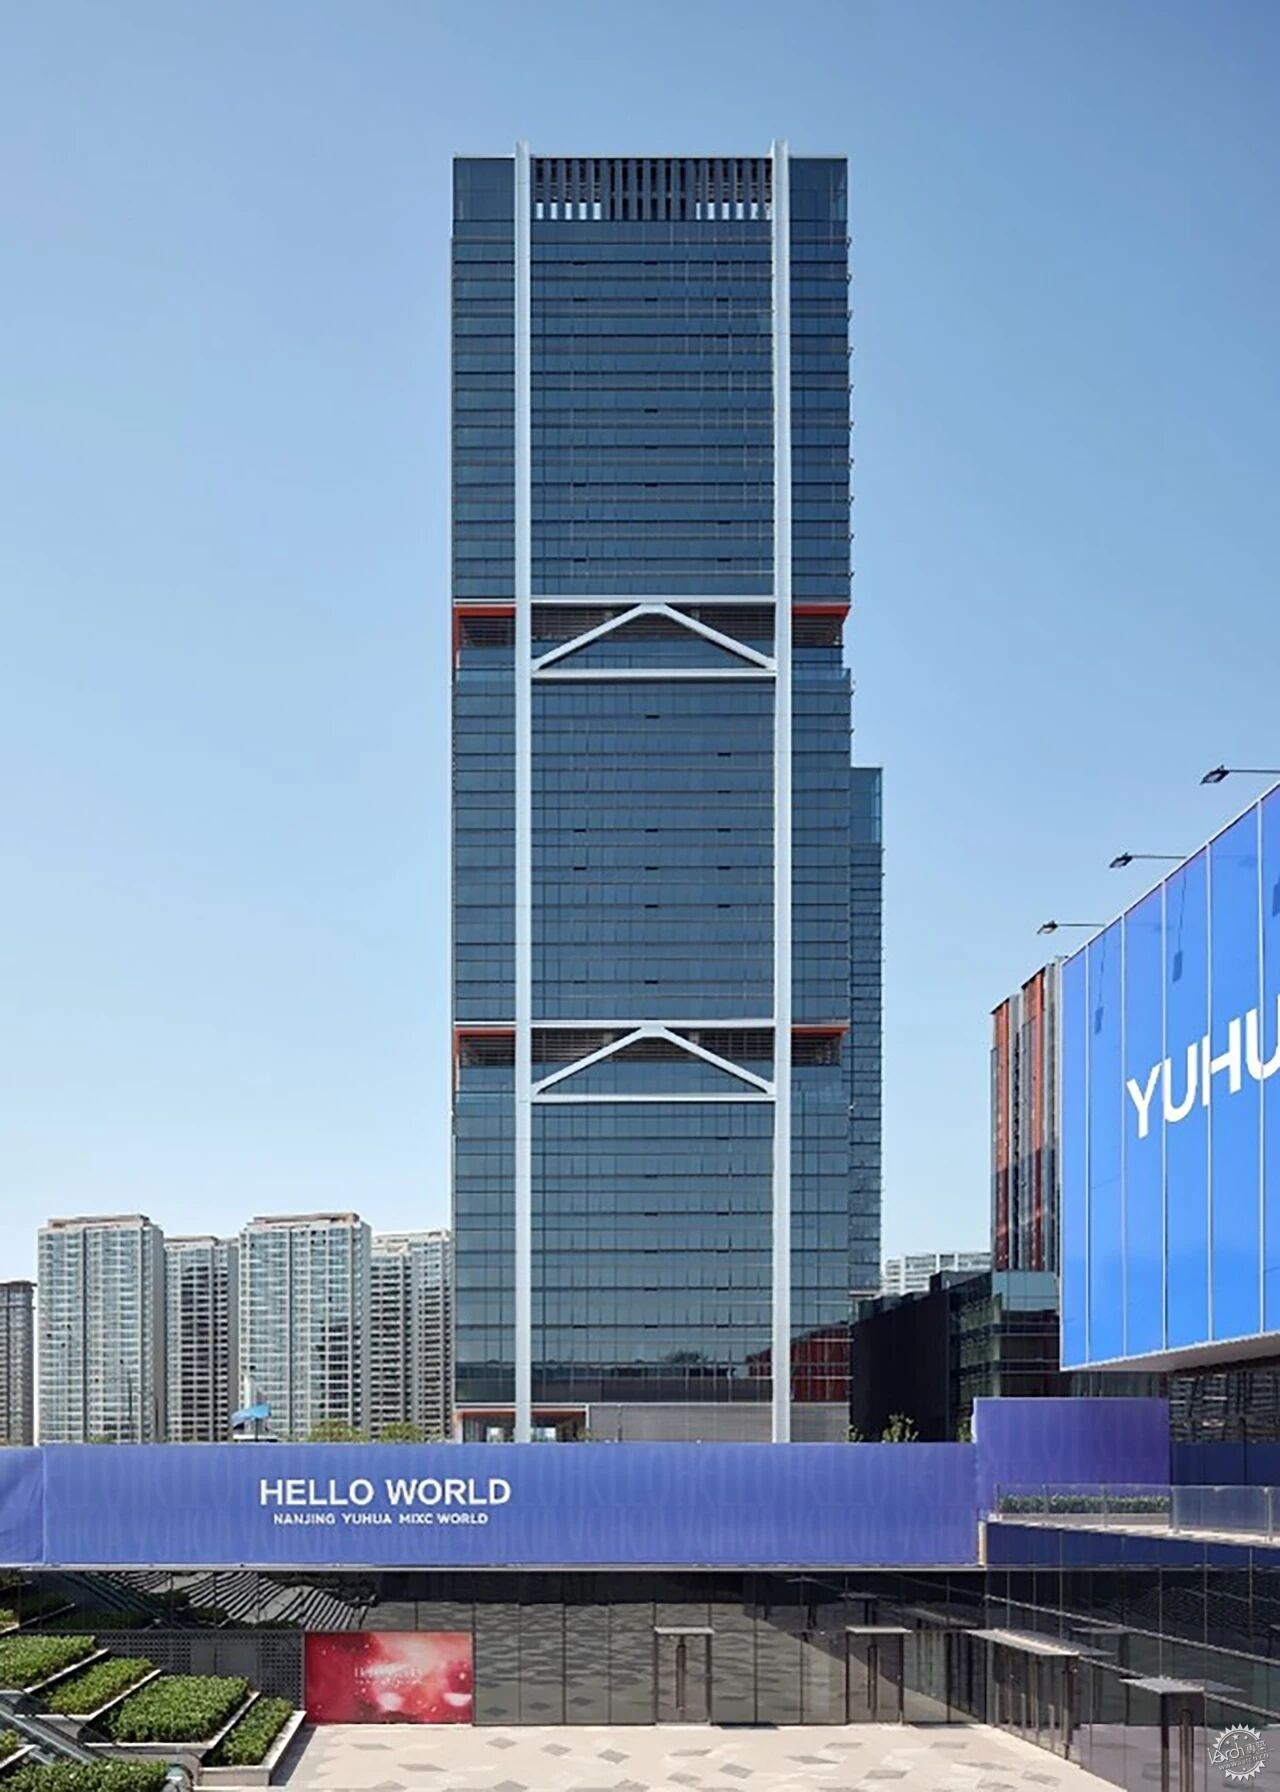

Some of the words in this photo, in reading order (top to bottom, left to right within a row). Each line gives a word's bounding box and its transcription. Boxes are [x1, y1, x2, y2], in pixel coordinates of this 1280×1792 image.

[260, 1478, 375, 1506] HELLO
[386, 1478, 512, 1506] WORLD
[273, 1513, 336, 1525] NANJING
[343, 1513, 392, 1525] YUHUA
[399, 1513, 433, 1525] MIXC
[436, 1513, 489, 1525] WORLD
